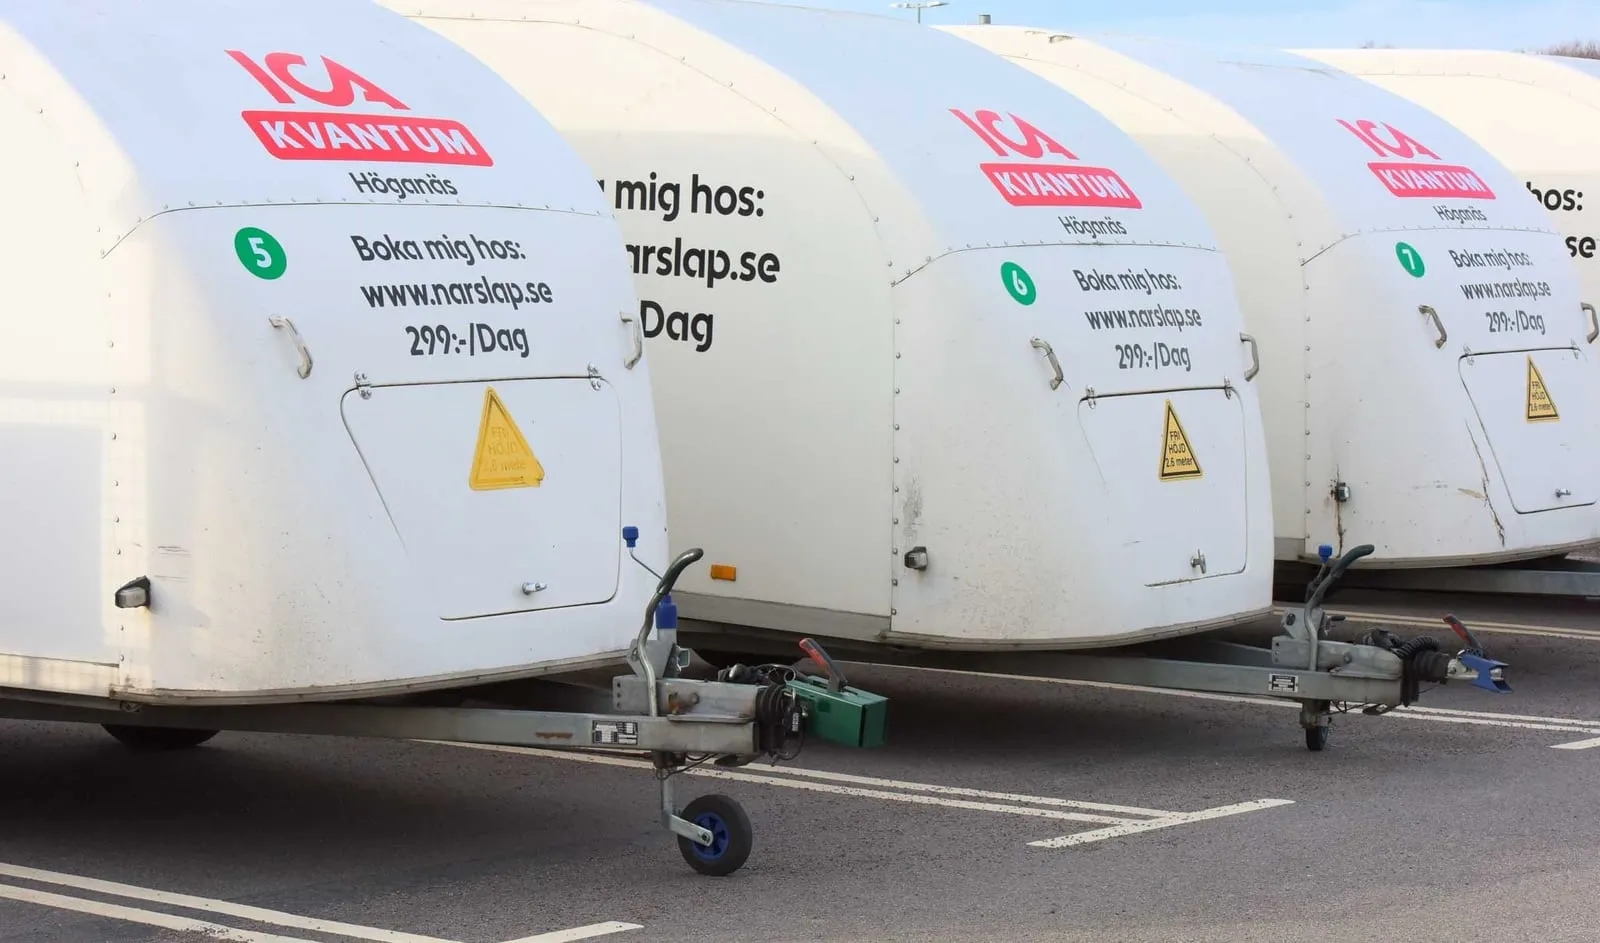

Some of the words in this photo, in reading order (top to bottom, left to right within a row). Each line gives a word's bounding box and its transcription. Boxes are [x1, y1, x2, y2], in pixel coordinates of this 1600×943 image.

[224, 50, 411, 110] ICA
[260, 120, 478, 156] KVANTUM
[948, 108, 1080, 160] ICA
[1335, 119, 1442, 160] ICA
[349, 171, 458, 199] Höganäs
[993, 171, 1131, 199] KVANTUM
[1378, 169, 1489, 192] KVANTUM
[615, 171, 680, 222] mig
[691, 173, 764, 217] hos:
[1058, 215, 1128, 239] Höganäs
[1433, 205, 1489, 224] Höganäs
[247, 237, 273, 268] 5
[350, 235, 423, 261] Boka
[423, 234, 474, 266] mig
[469, 234, 526, 260] hos:
[1448, 249, 1486, 268] Boka
[1485, 249, 1511, 270] mig
[360, 276, 553, 310] www.narslap.se
[1012, 270, 1028, 296] 6
[1072, 269, 1120, 292] Boka
[1119, 269, 1151, 295] mig
[1144, 268, 1182, 290] hos:
[1460, 277, 1552, 301] www.narslap.se
[640, 300, 713, 352] Dag
[1085, 303, 1202, 332] www.narslap.se
[405, 322, 530, 358] 299:-/Dag
[1115, 342, 1191, 371] 299:-/Dag
